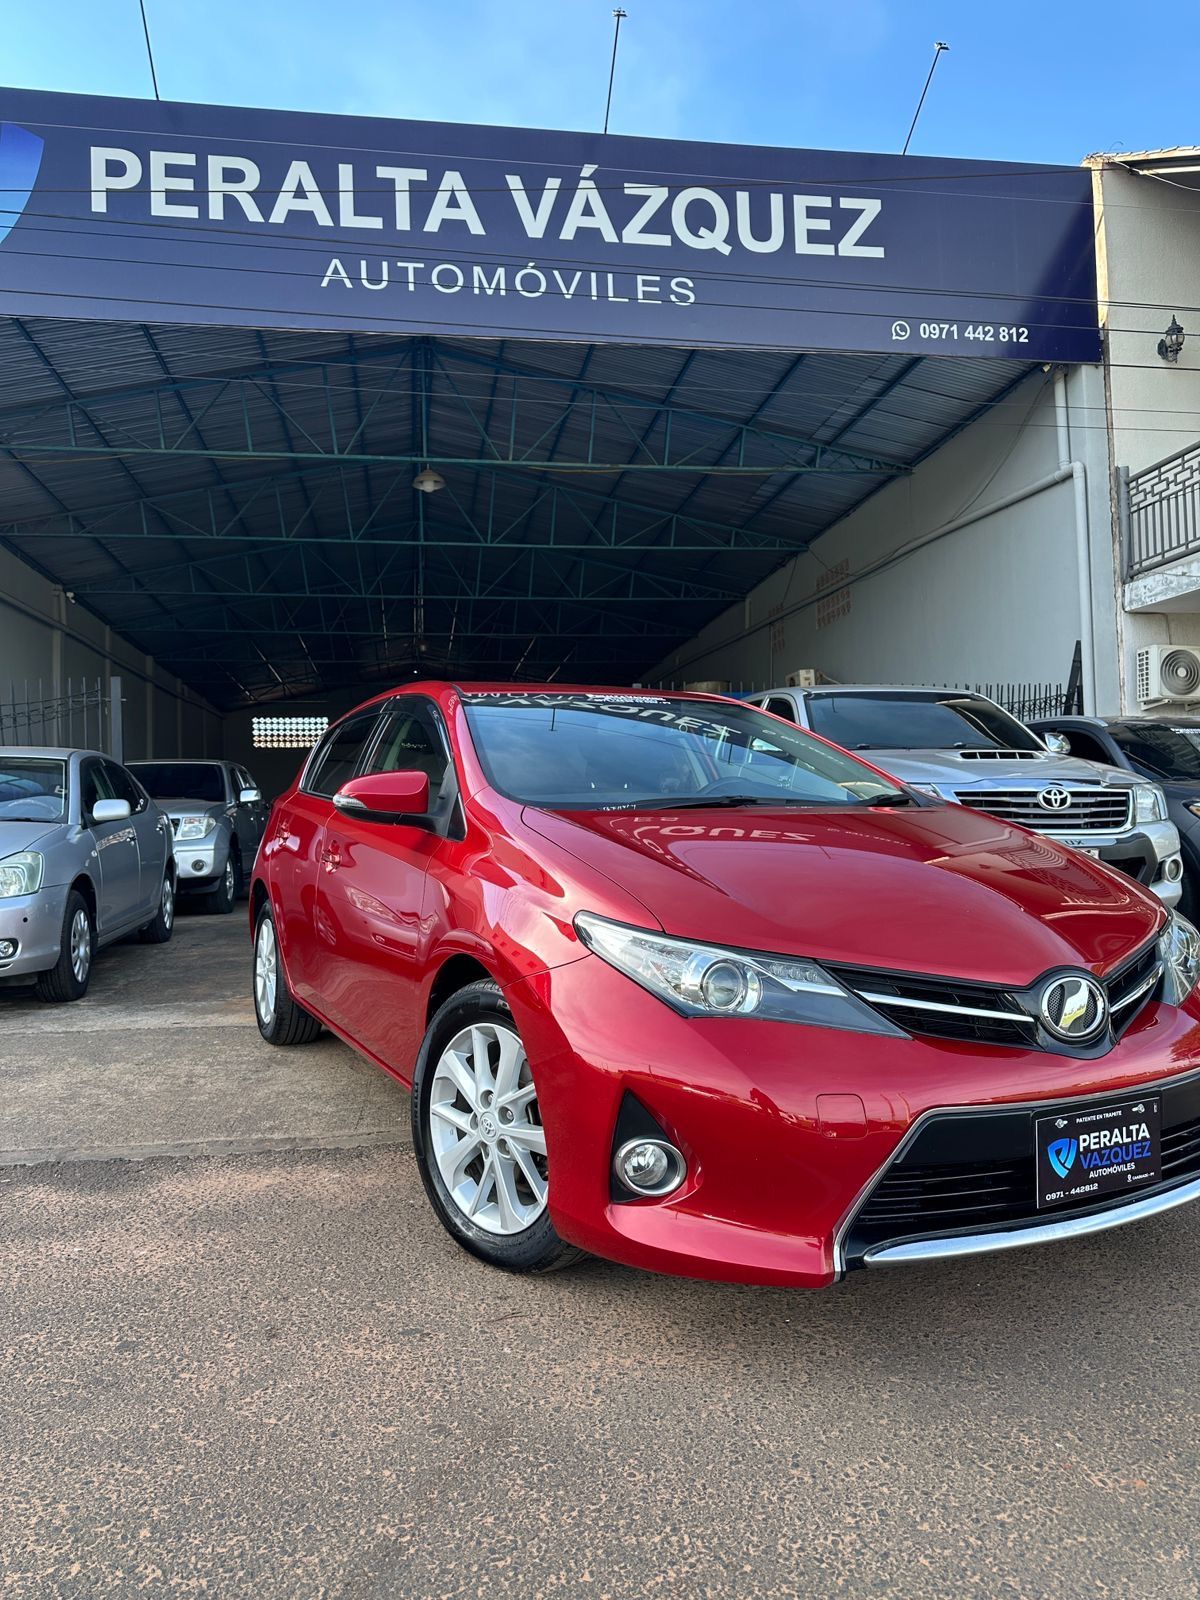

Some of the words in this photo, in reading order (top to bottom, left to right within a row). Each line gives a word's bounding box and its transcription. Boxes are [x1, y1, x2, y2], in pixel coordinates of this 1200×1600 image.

[90, 146, 486, 236] PERALTA
[505, 163, 885, 258] VÁZQUEZ
[320, 258, 696, 306] AUTOMÓVILES
[919, 323, 958, 339] 0971
[964, 325, 995, 341] 442
[999, 327, 1029, 343] 812
[1075, 1115, 1096, 1124] PATENTE
[1103, 1110, 1122, 1119] TRAMITE
[1079, 1122, 1150, 1152] PERALTA
[1080, 1141, 1151, 1169] VAZQUEZ
[1089, 1162, 1136, 1179] AUTOMÓVILES
[1045, 1191, 1064, 1201] 0971
[1070, 1183, 1099, 1195] 442812
